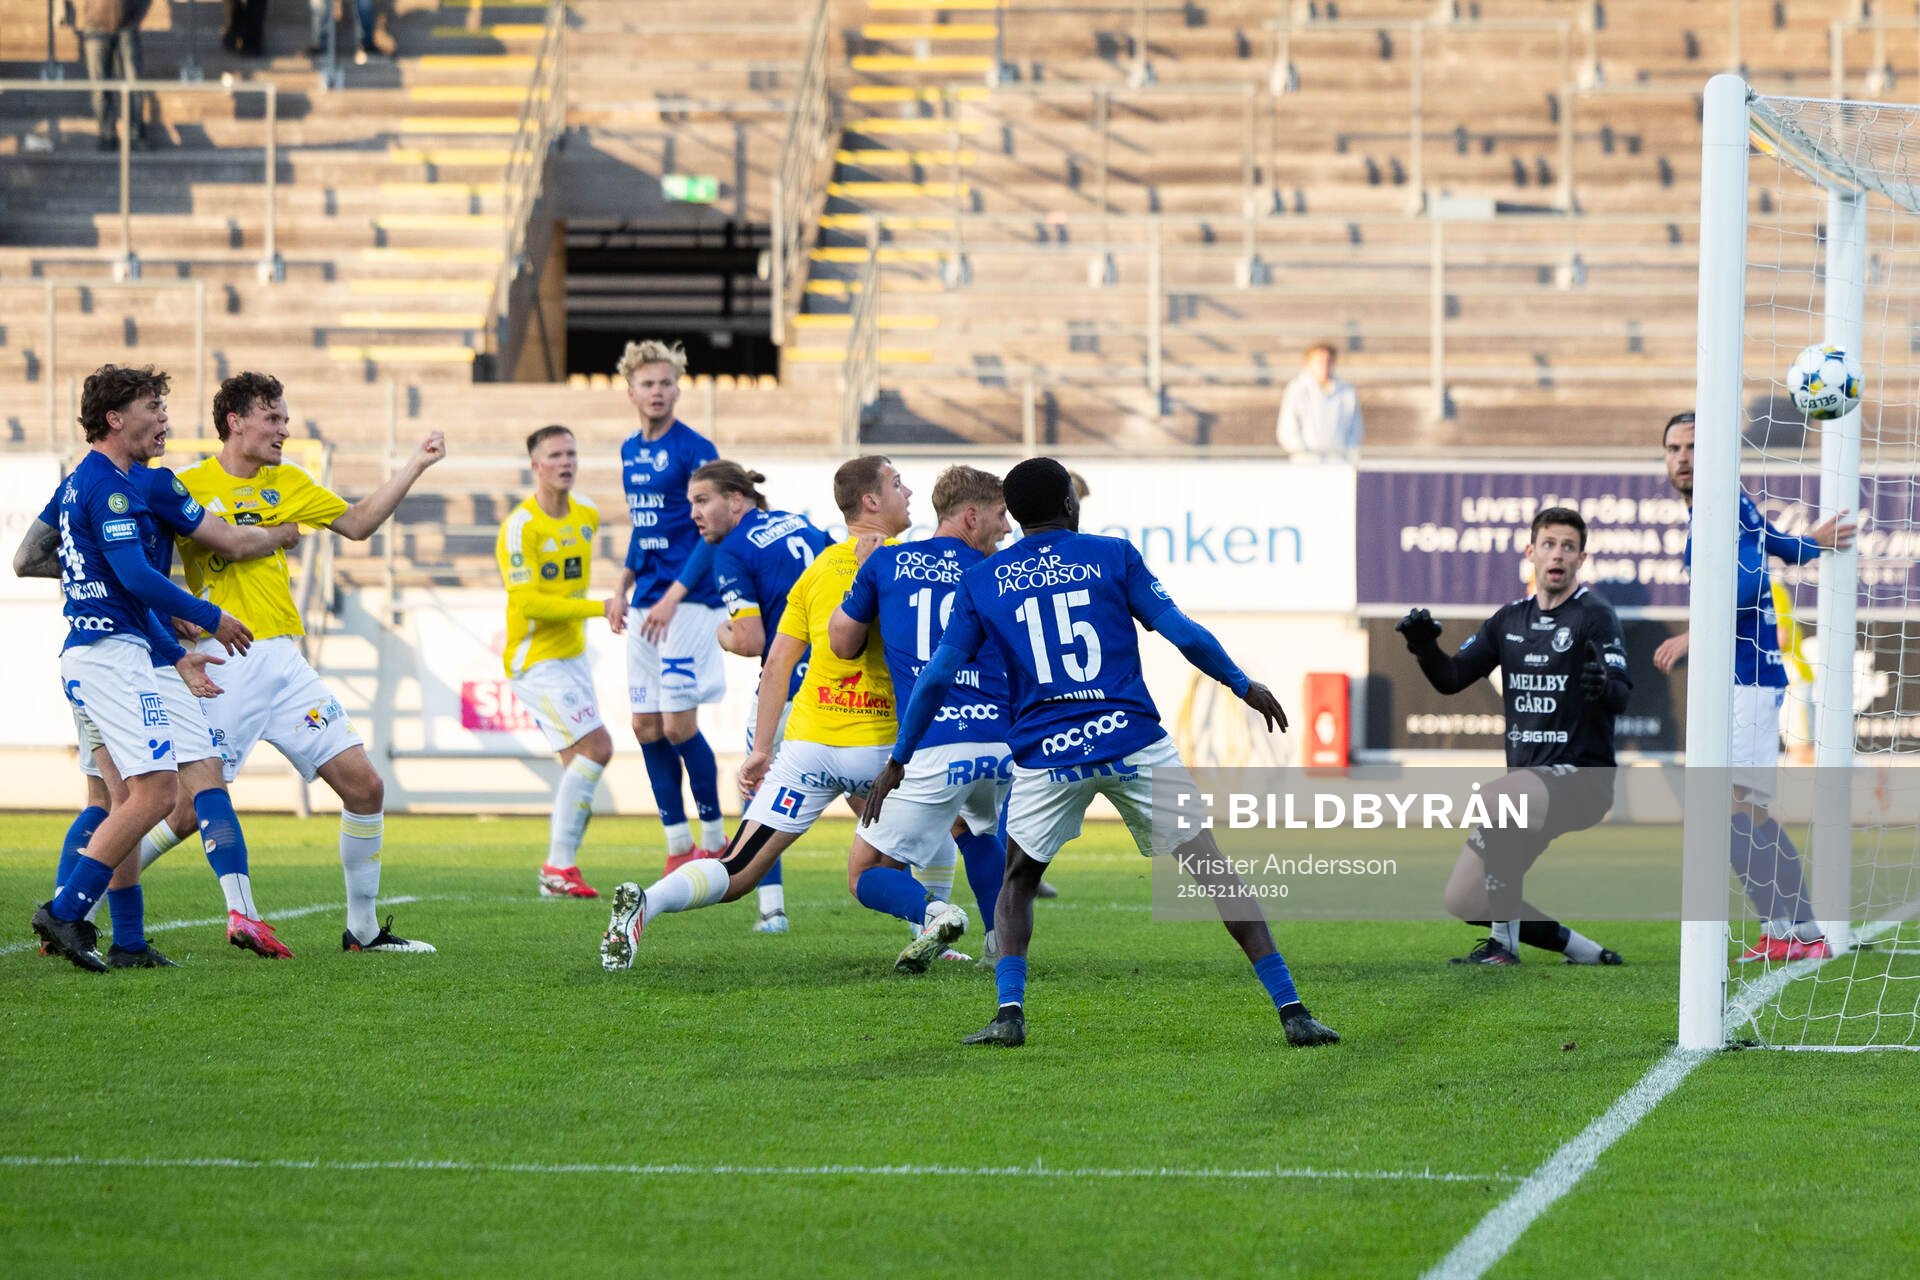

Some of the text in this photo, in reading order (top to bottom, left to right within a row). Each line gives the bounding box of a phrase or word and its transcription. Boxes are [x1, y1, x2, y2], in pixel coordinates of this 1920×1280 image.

[105, 523, 136, 534] UNIBET
[631, 509, 658, 528] ÅRD
[895, 551, 964, 573] OSCAR
[994, 554, 1078, 580] OSCAR
[998, 563, 1101, 597] JACOBSON
[1015, 588, 1102, 685] 15
[1508, 673, 1569, 692] MELLBY
[1514, 692, 1557, 713] GÅRD
